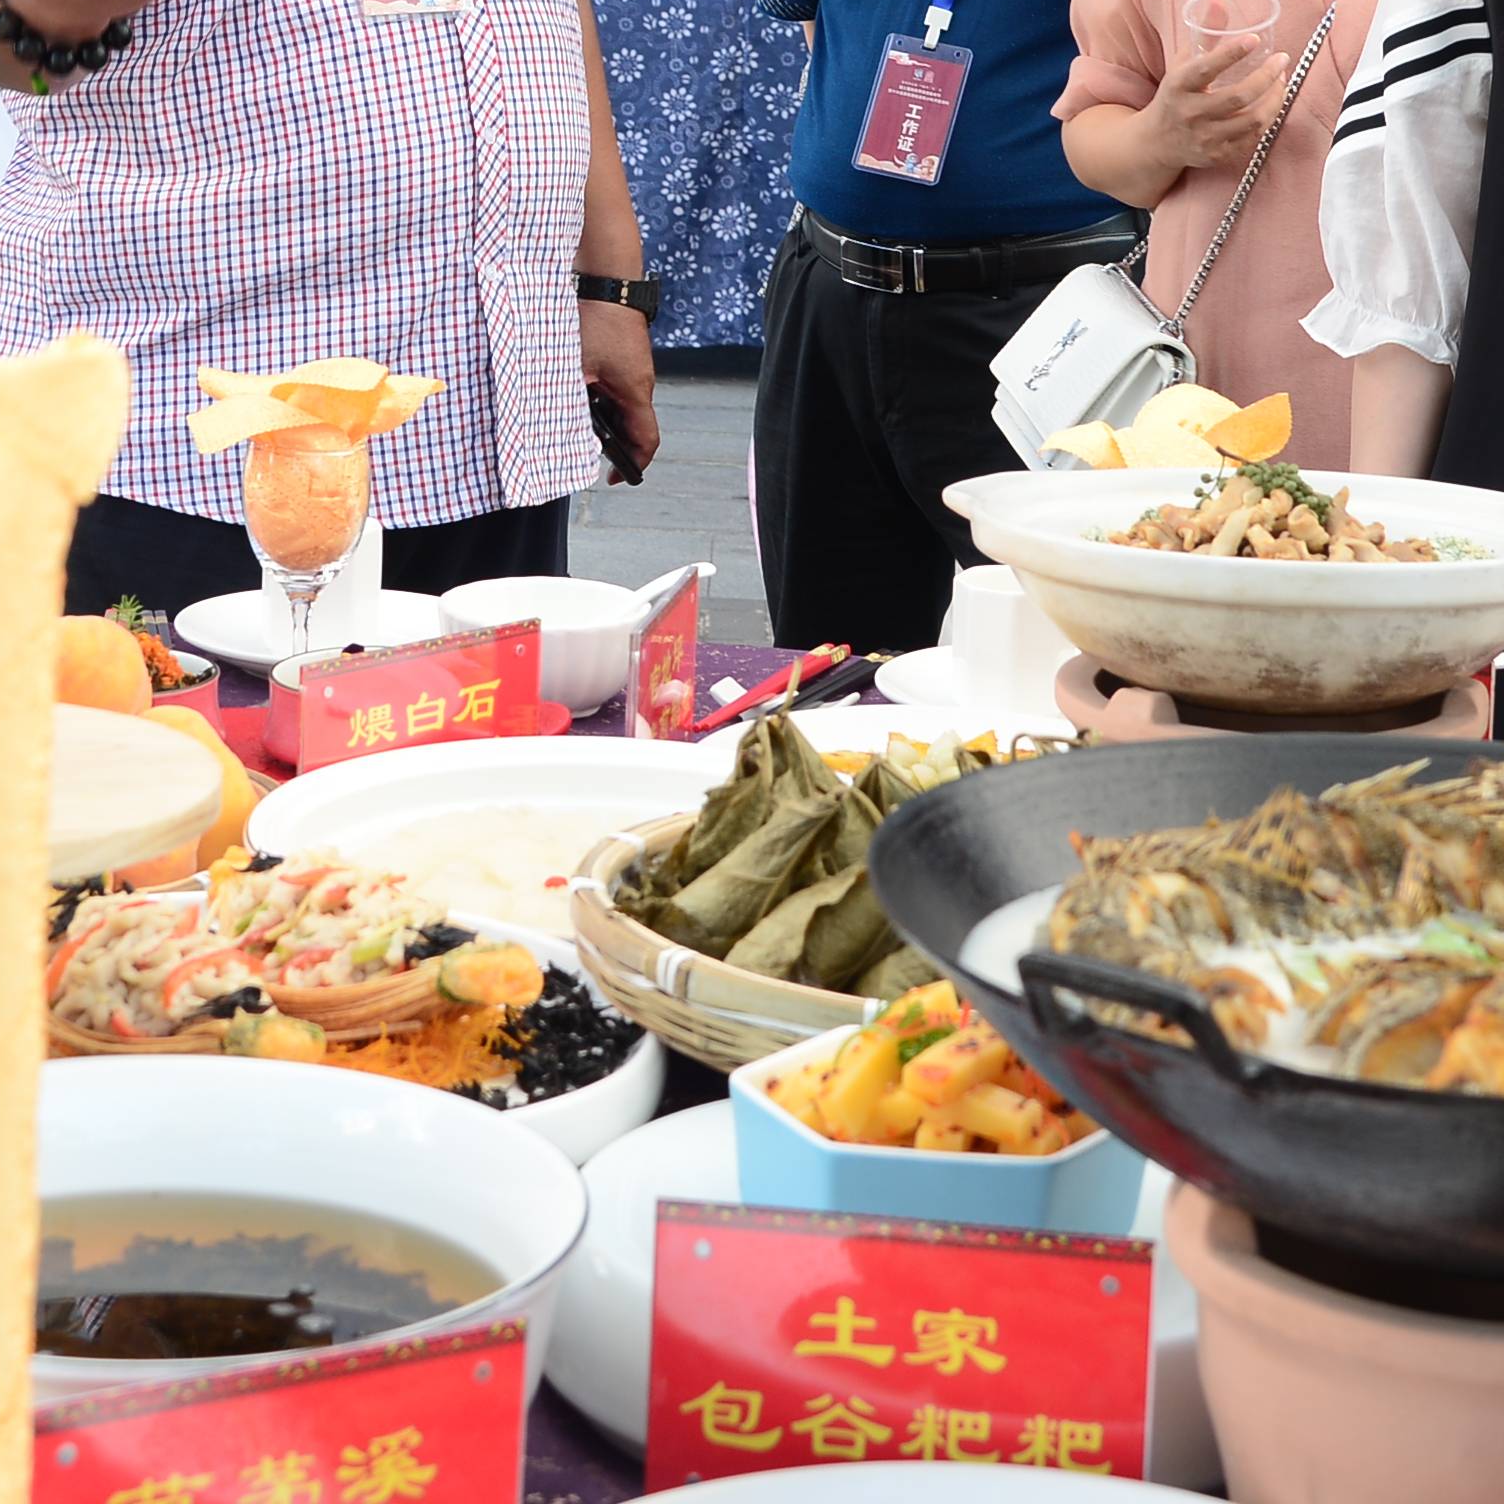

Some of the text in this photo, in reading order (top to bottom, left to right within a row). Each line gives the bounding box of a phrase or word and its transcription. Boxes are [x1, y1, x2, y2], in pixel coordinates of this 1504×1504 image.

[897, 103, 923, 152] 工作证
[347, 678, 502, 748] 煨白石
[792, 1295, 1007, 1375] 土家
[679, 1380, 1113, 1476] 包谷粑粑
